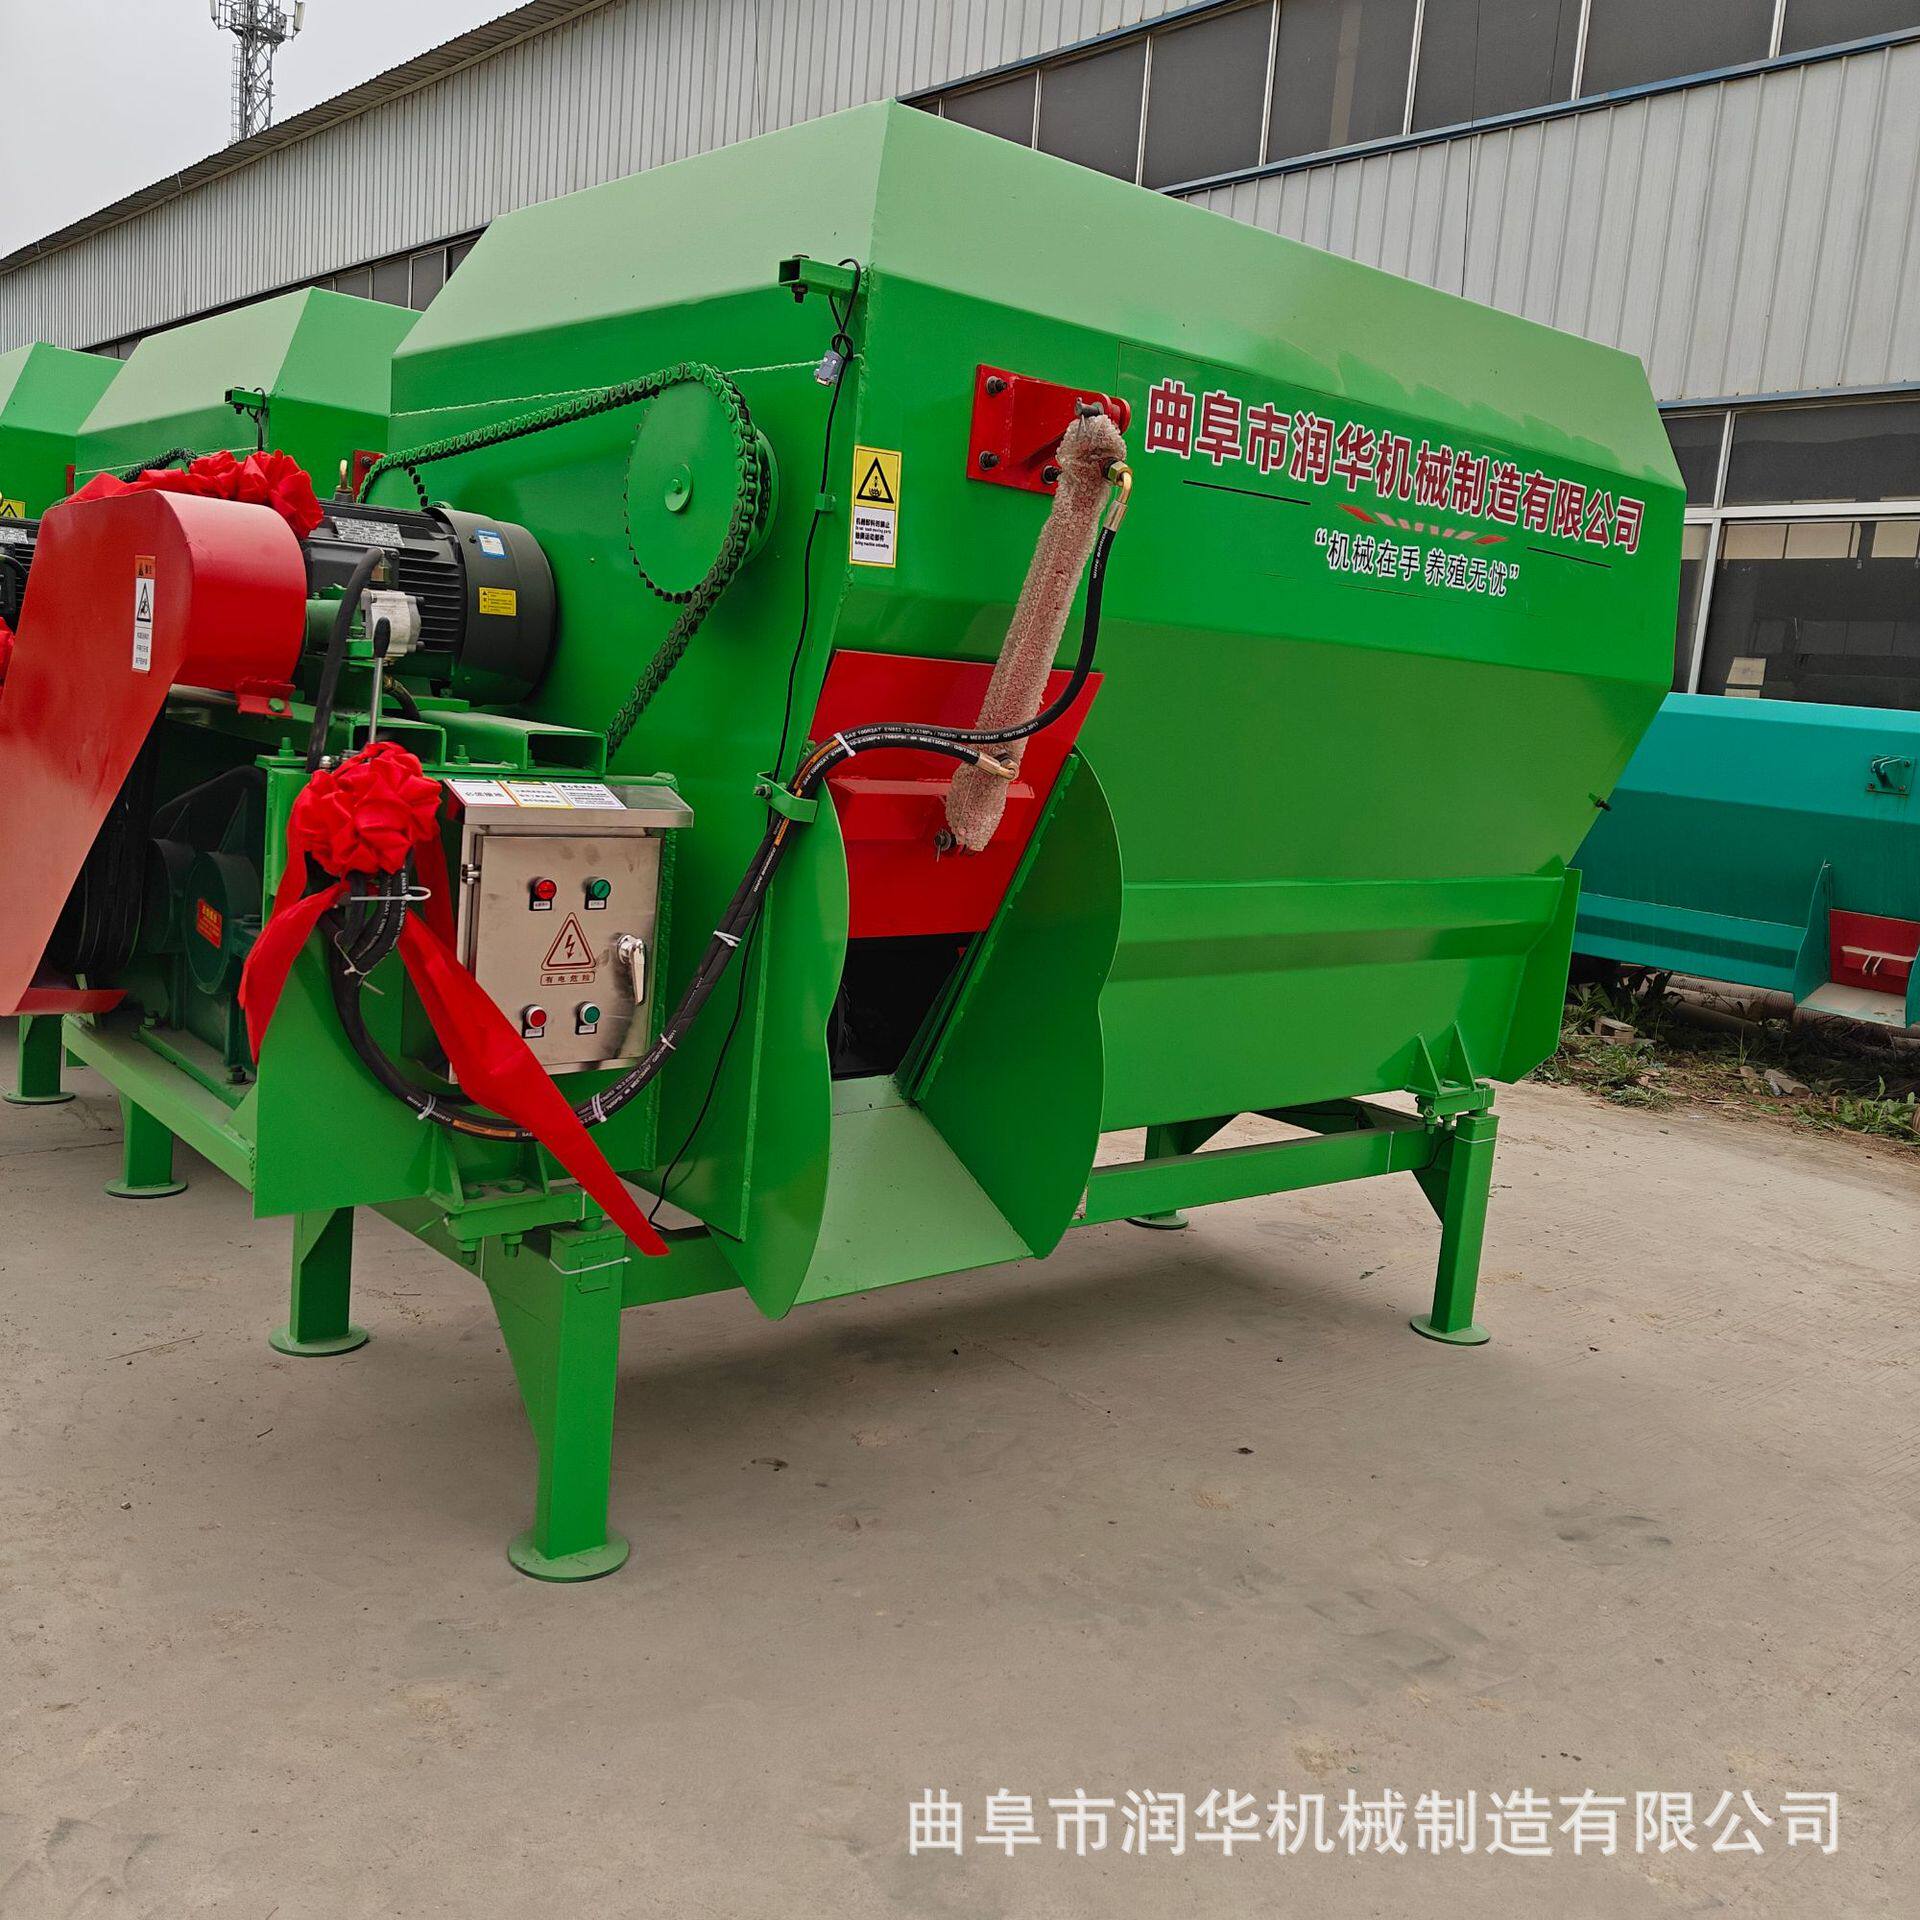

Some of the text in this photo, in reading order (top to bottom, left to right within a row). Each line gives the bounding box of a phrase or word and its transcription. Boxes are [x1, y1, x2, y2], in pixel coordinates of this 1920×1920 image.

[1145, 377, 1645, 553] 曲阜市润华机械制造有限公司
